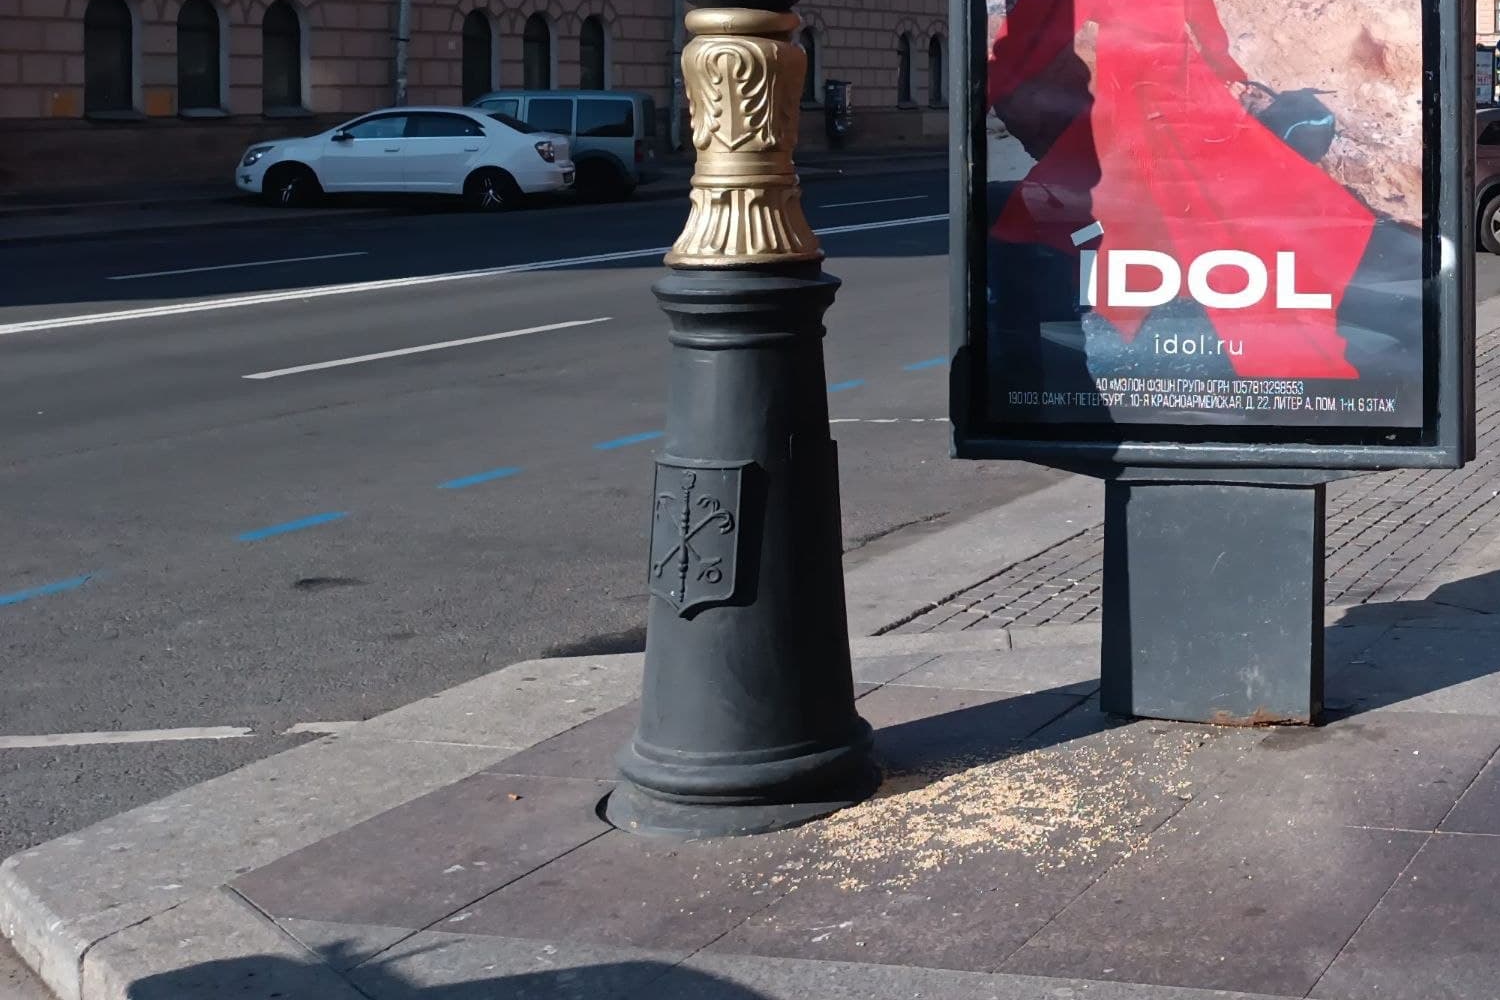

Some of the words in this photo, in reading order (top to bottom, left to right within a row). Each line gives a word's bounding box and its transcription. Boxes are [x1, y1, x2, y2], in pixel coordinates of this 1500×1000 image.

[1154, 334, 1244, 355] idol.ru
[1095, 378, 1108, 391] АО
[1147, 378, 1176, 392] ФЭШН
[1177, 379, 1205, 393] ГРУП»
[1206, 380, 1230, 394] ОГРН
[1130, 393, 1150, 407] 10-Я
[1273, 396, 1303, 410] ЛИТЕР
[1358, 398, 1365, 411] 6
[1366, 398, 1395, 412] ЭТАЖ
